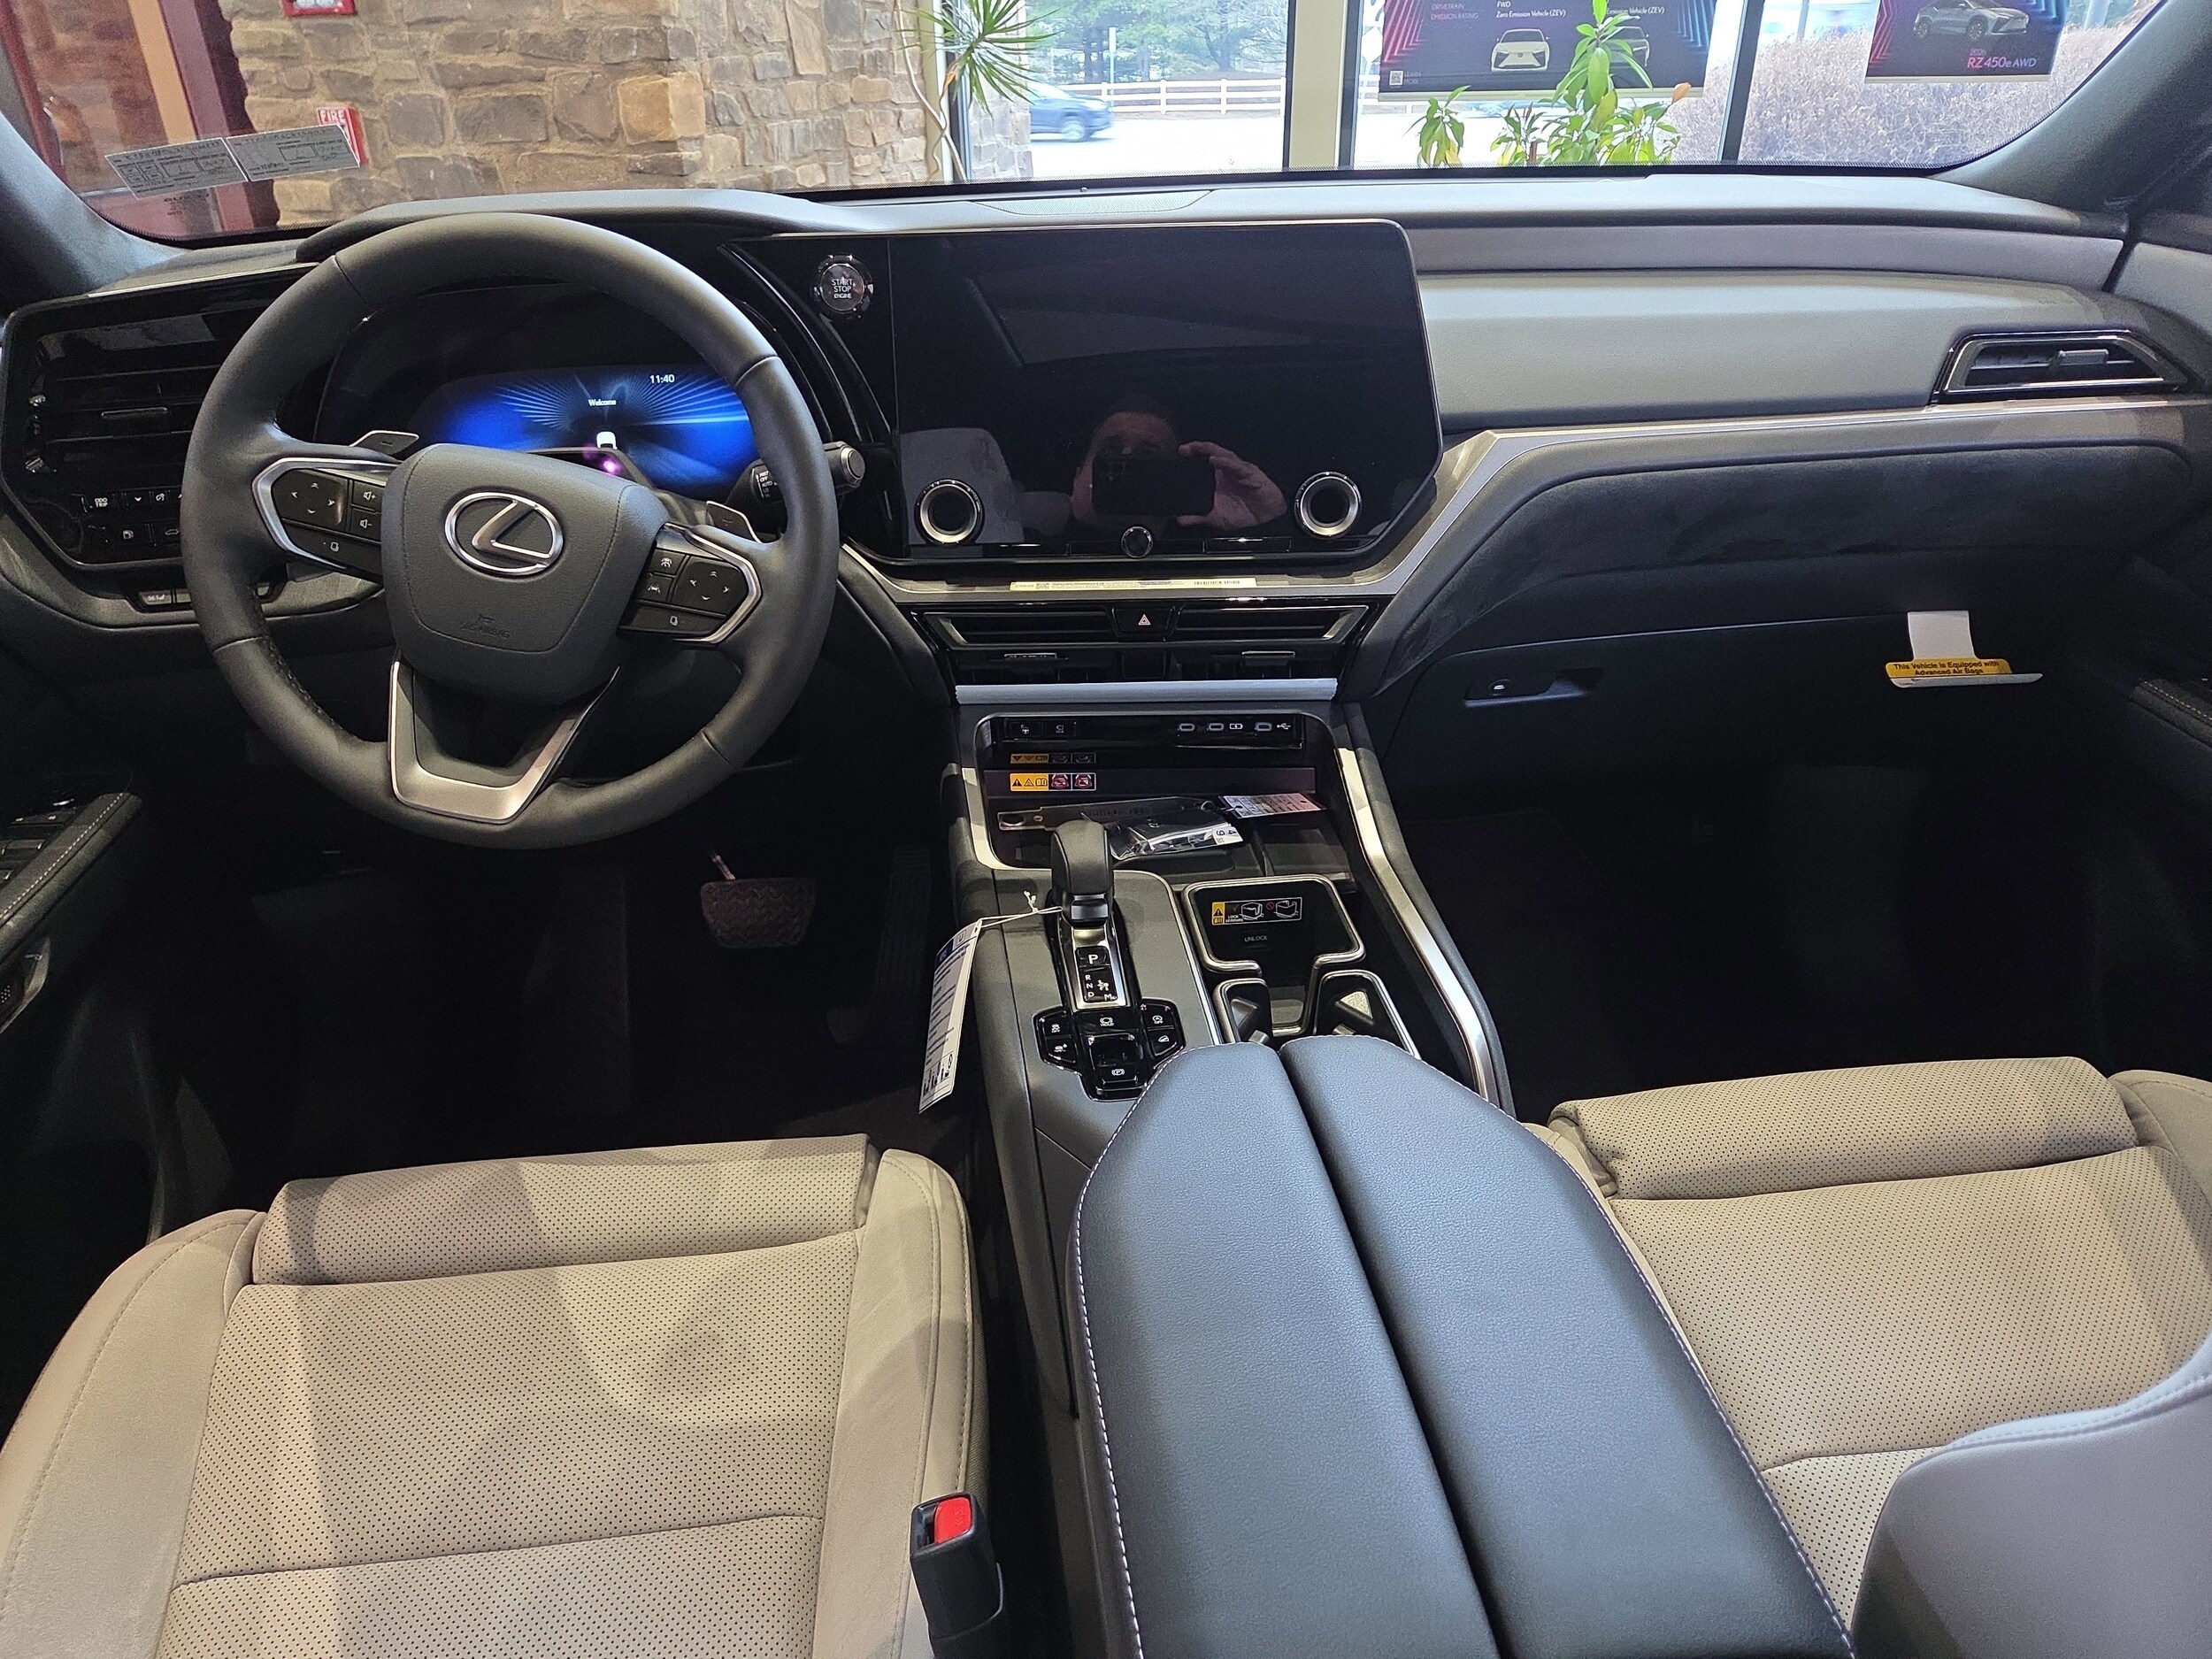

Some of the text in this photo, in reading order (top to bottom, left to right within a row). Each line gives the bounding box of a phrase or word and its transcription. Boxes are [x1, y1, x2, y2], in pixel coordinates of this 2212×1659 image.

[1967, 57, 2037, 68] RZ 450e AWD
[319, 109, 347, 125] FIRE
[649, 374, 675, 384] 11:40
[1947, 661, 1983, 670] Equipped
[1088, 954, 1099, 964] P
